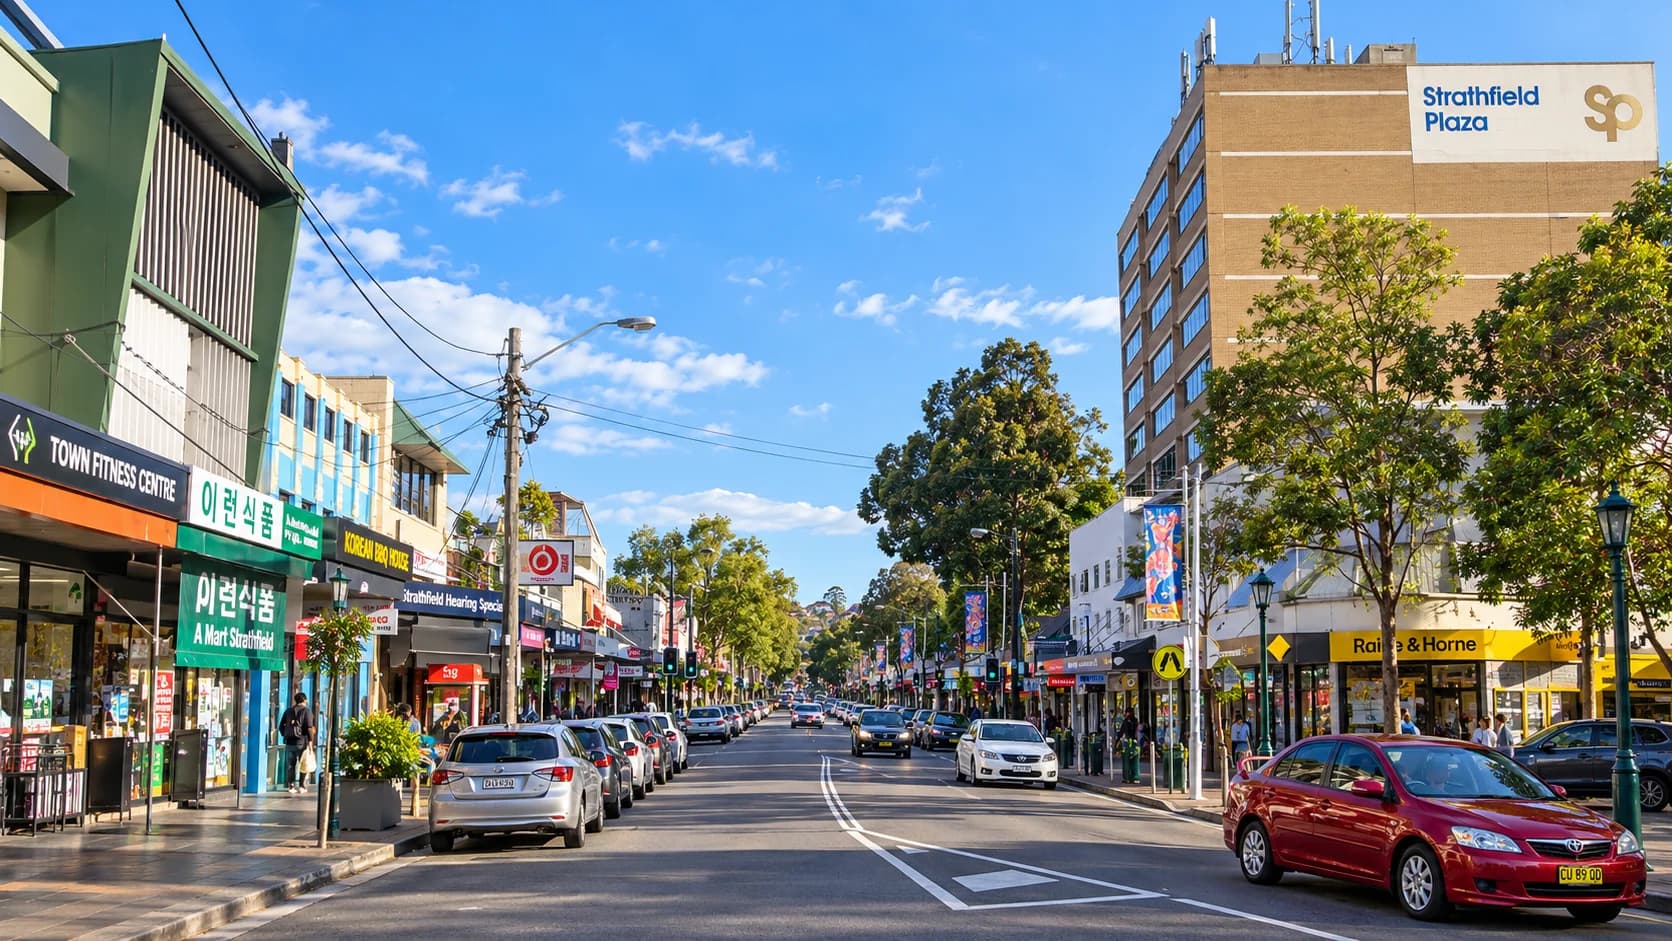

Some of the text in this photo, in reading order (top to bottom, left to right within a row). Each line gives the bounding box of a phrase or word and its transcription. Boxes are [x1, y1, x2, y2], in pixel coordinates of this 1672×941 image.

[1423, 85, 1540, 106] Strathfield
[1425, 112, 1488, 132] Plaza
[50, 435, 176, 503] TOWN FITNESS CENTRE
[344, 530, 374, 560] KOREAN
[389, 547, 410, 572] HOUSE
[445, 592, 477, 612] Hearing
[479, 597, 503, 614] Specia
[193, 622, 203, 645] A
[204, 623, 229, 647] Mart
[1353, 636, 1477, 653] Raie & Horne
